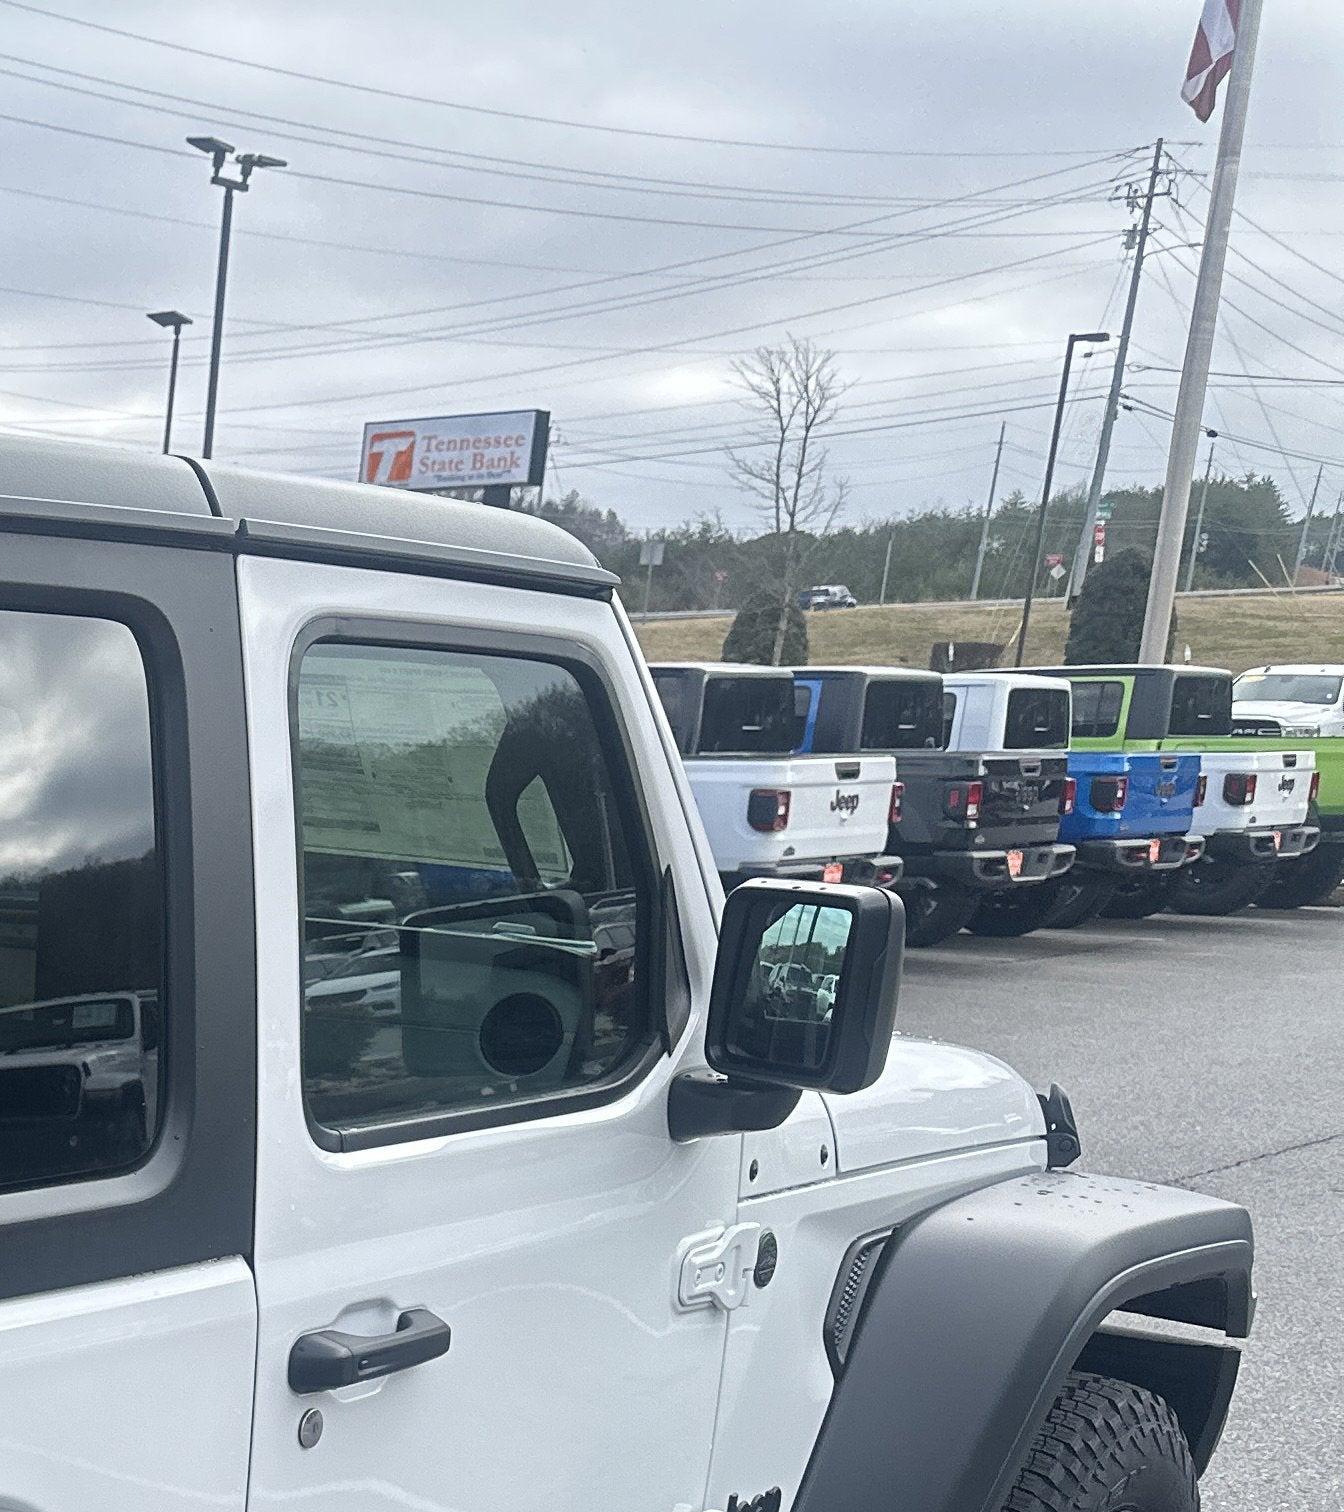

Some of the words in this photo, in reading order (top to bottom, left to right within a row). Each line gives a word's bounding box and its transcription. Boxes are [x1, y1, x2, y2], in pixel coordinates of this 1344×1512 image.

[421, 432, 527, 453] Tennessee
[418, 456, 465, 474] State
[471, 451, 521, 471] Bank
[830, 789, 859, 815] Jeep
